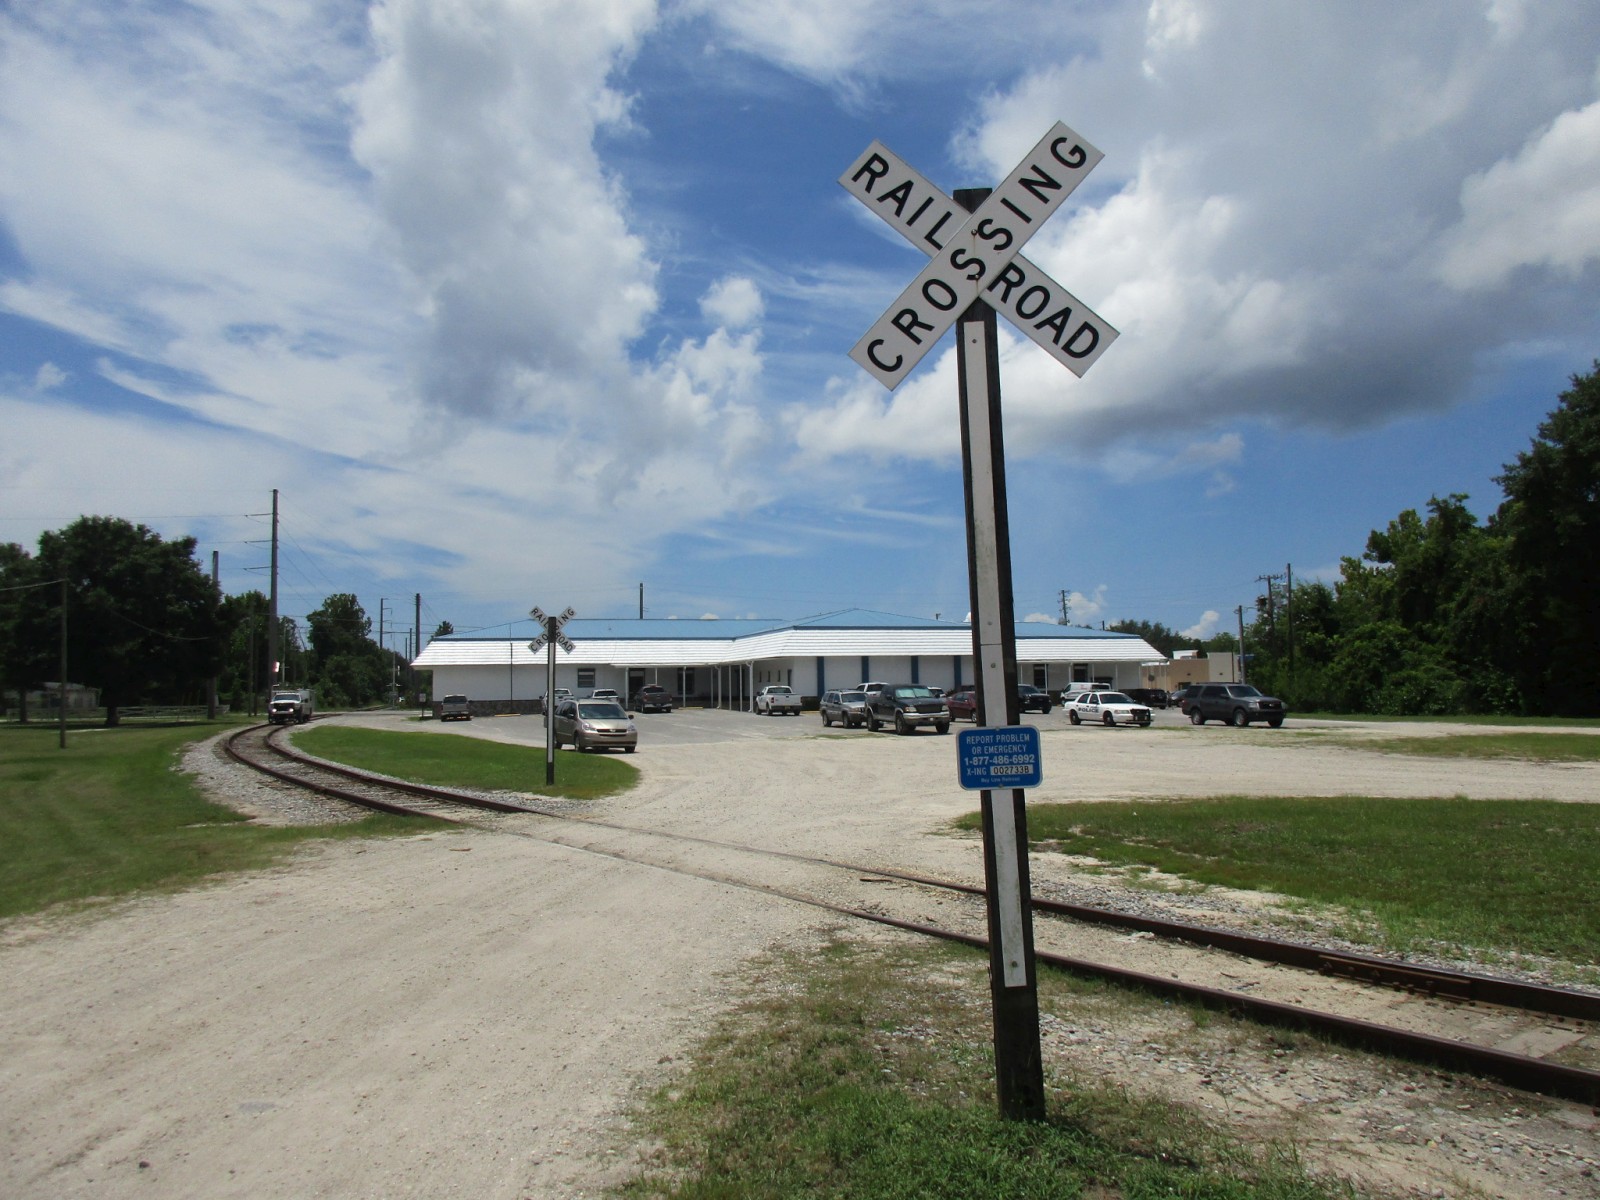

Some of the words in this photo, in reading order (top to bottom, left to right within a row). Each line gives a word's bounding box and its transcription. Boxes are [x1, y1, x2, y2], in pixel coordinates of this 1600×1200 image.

[851, 152, 952, 250] RAIL
[986, 262, 1099, 359] ROAD
[866, 136, 1087, 372] CROSSING
[531, 608, 549, 629] RAIL
[555, 632, 573, 652] ROAD
[966, 735, 994, 744] REPORT
[996, 733, 1030, 743] PROBLEM
[971, 746, 982, 754] OR
[983, 744, 1027, 754] EMERGENCY
[964, 754, 1035, 766] 1-877-486-6992
[966, 767, 987, 776] X-ING
